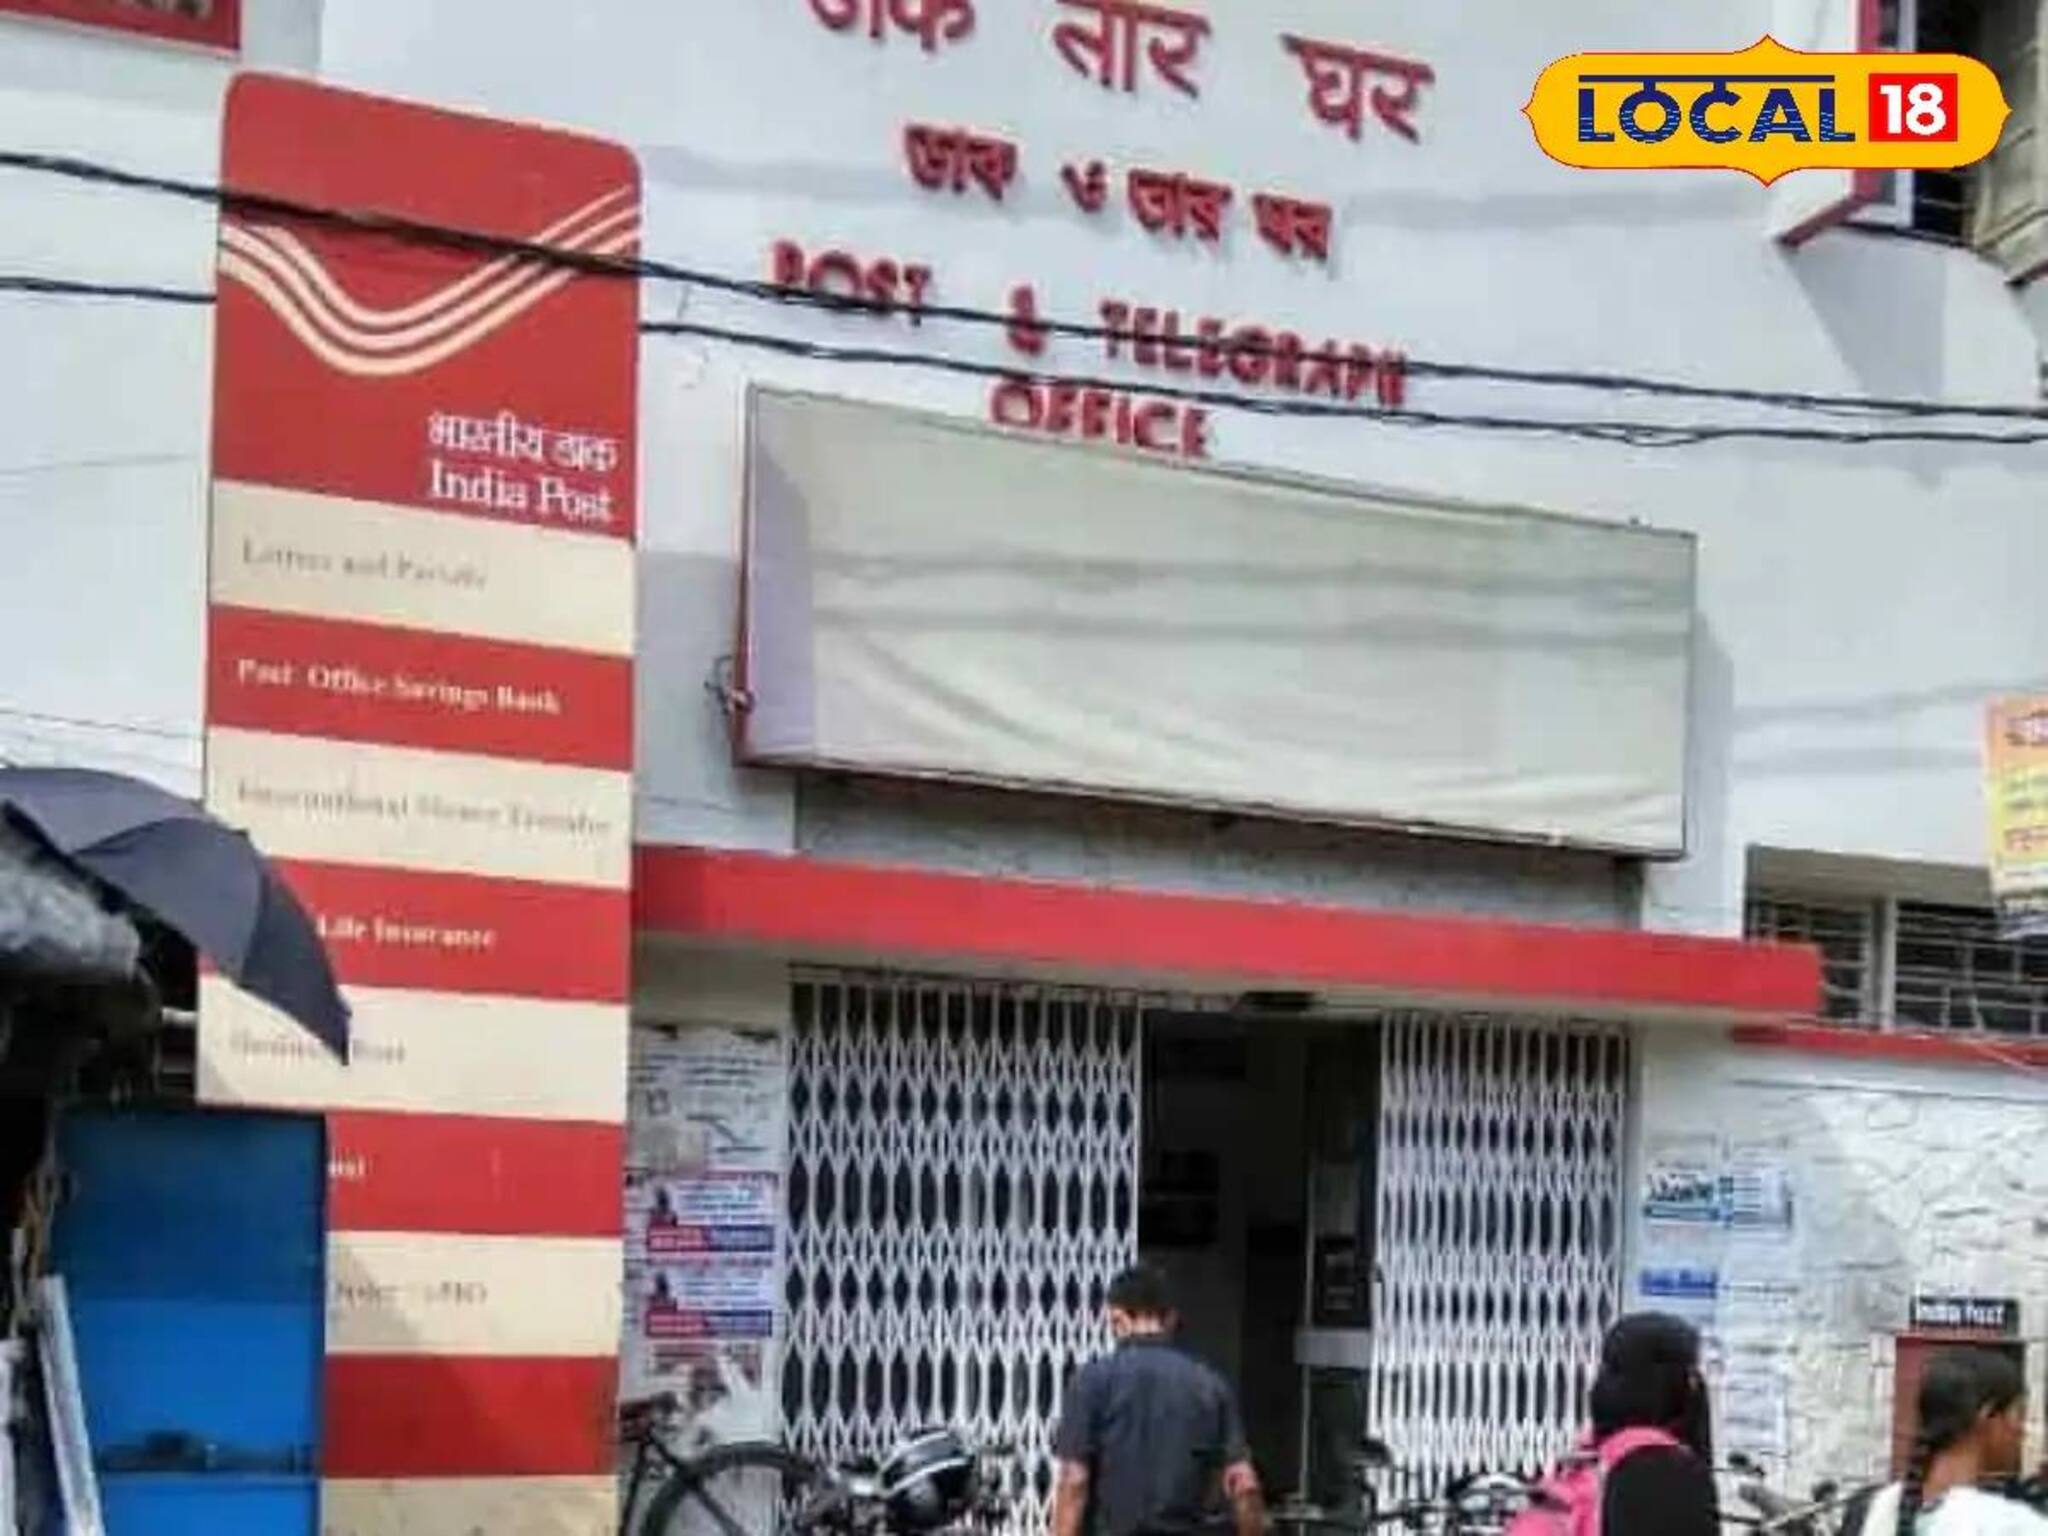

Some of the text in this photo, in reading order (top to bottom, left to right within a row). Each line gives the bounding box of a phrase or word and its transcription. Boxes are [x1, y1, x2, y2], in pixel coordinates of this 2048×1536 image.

[1054, 0, 1212, 98] तार
[1280, 33, 1436, 144] घर
[904, 125, 1017, 200] ডাক
[1127, 168, 1233, 241] তার
[773, 239, 932, 327] POST
[1100, 300, 1406, 407] TELEGRAPH
[429, 411, 620, 472] भारतीय डाक
[992, 380, 1209, 458] OFFICE
[433, 459, 613, 522] India Post
[237, 657, 561, 716] Post Office Savings Bank
[316, 914, 494, 947] Life Insurance
